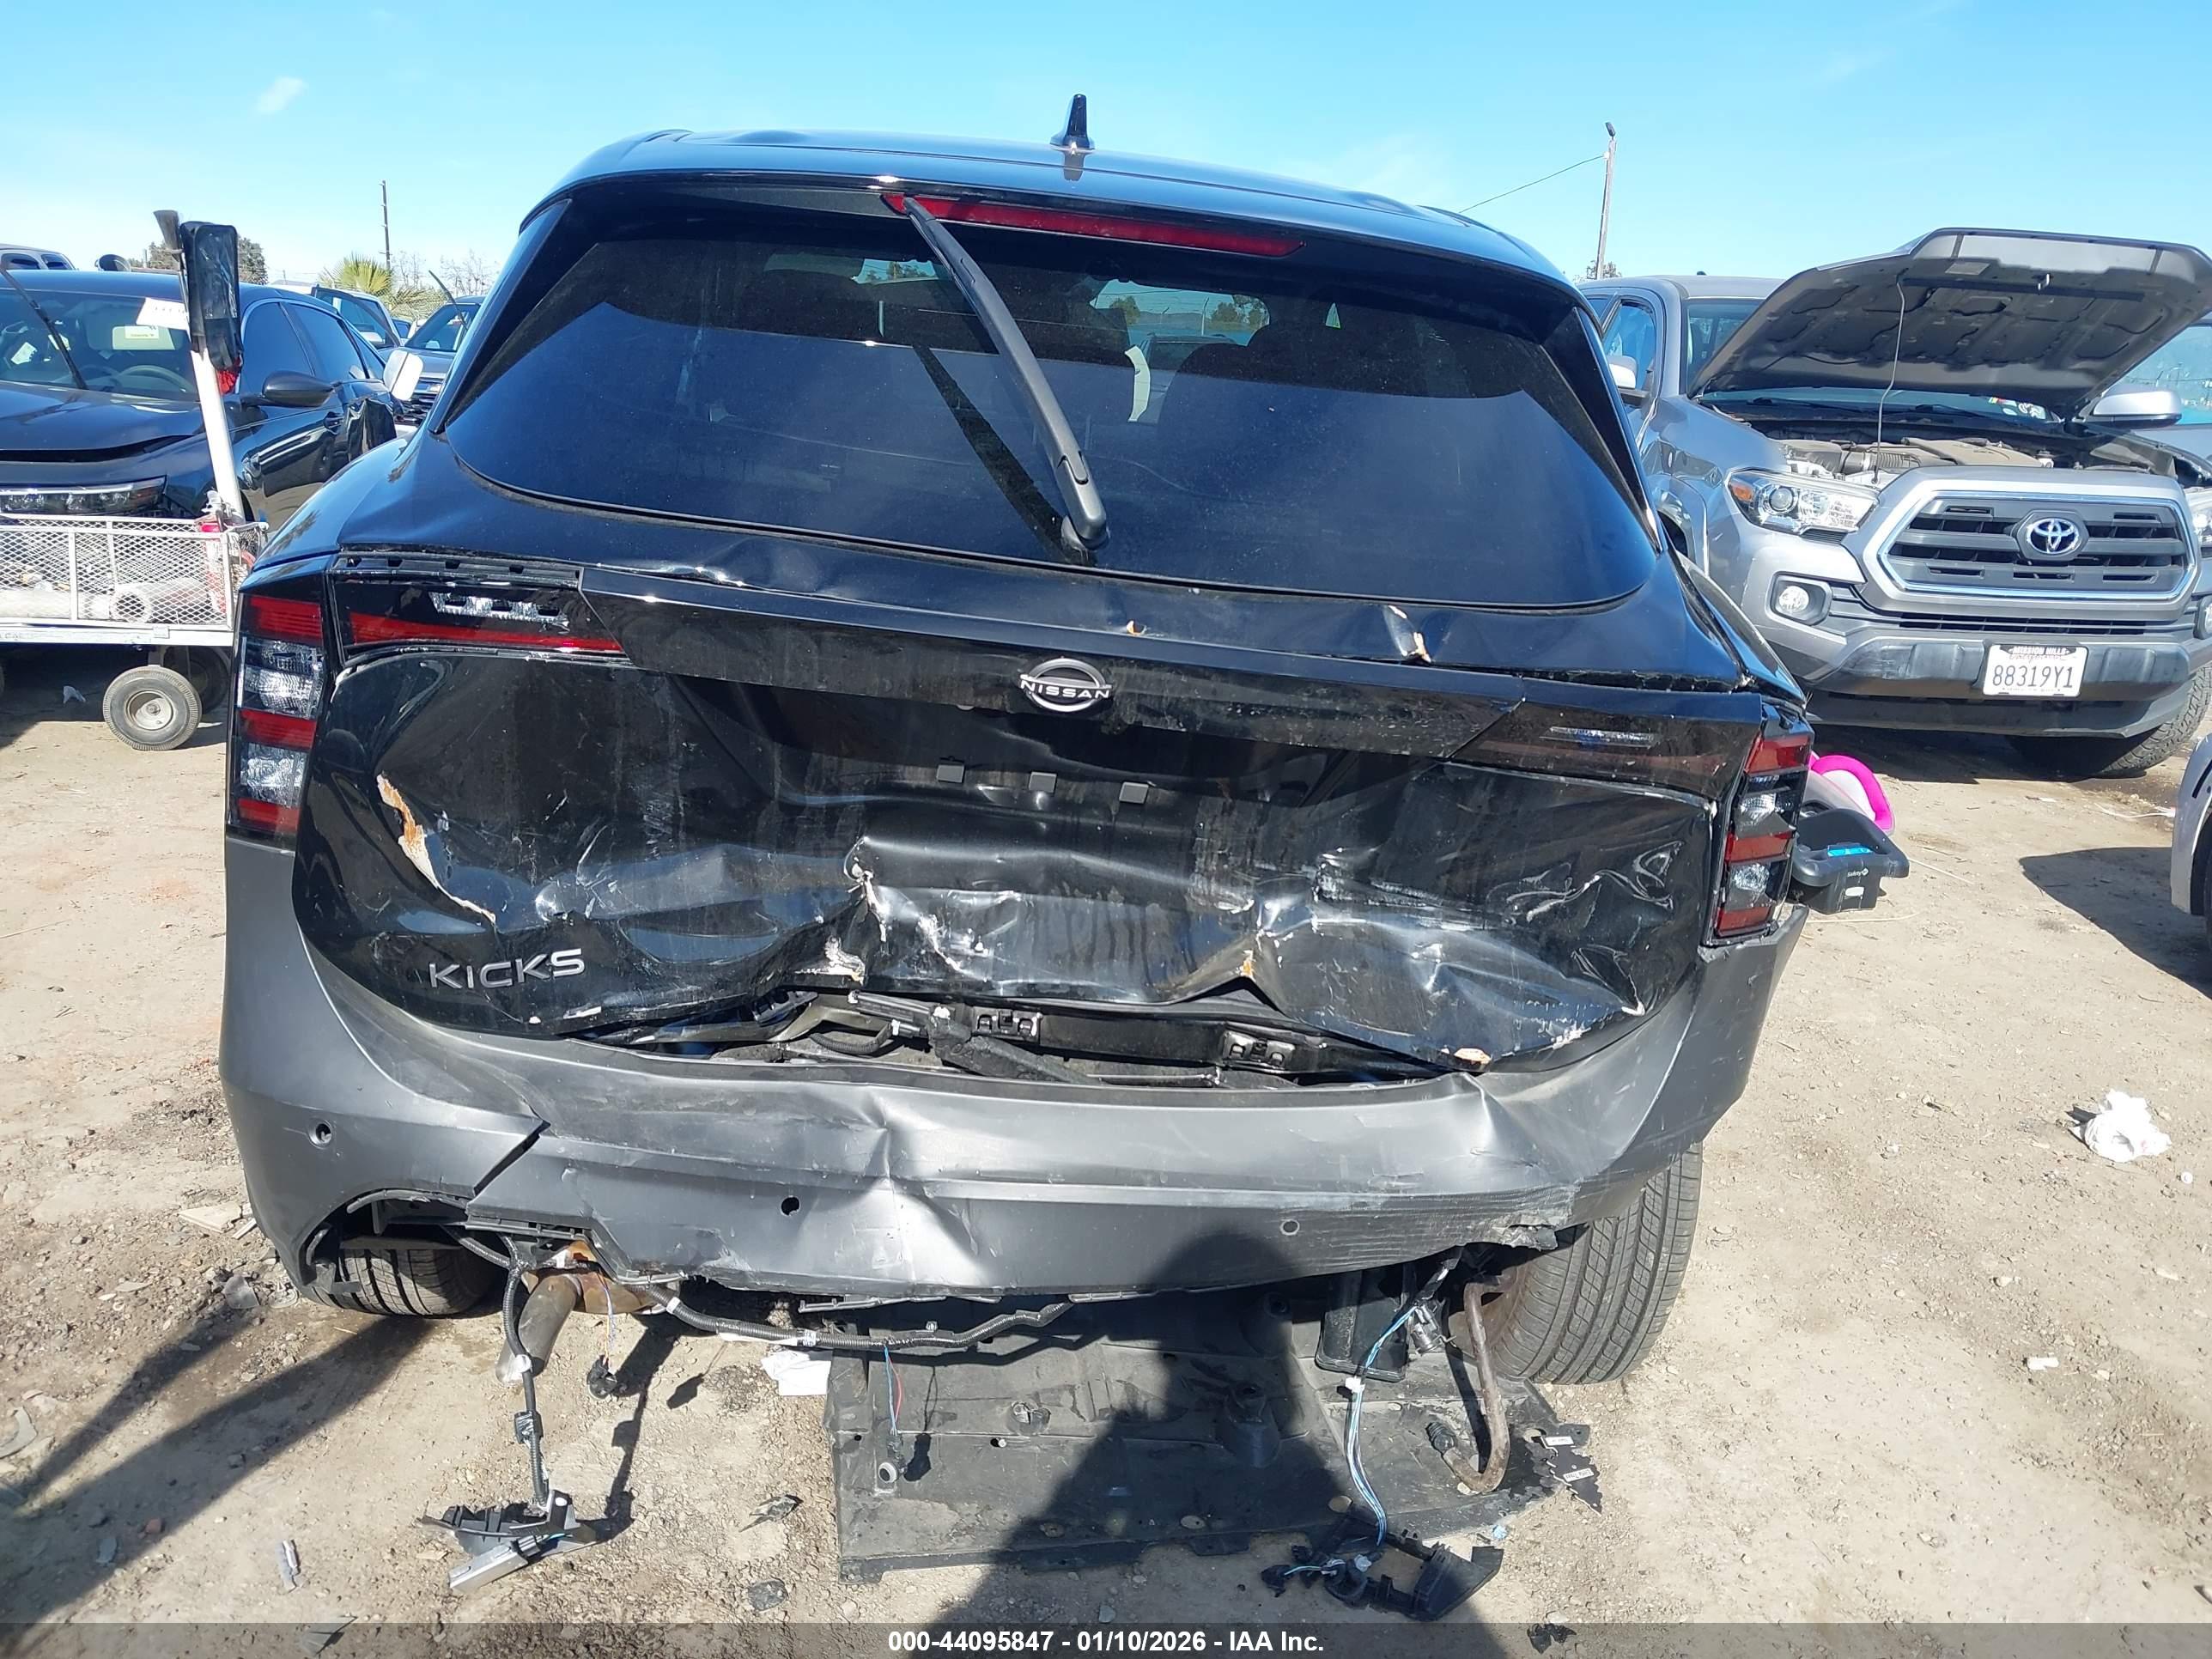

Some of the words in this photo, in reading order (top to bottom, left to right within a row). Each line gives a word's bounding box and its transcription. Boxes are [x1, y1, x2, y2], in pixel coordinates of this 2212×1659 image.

[1020, 679, 1110, 699] NISSAN
[1992, 665, 2072, 689] 88319Y1
[428, 947, 586, 989] KICKS
